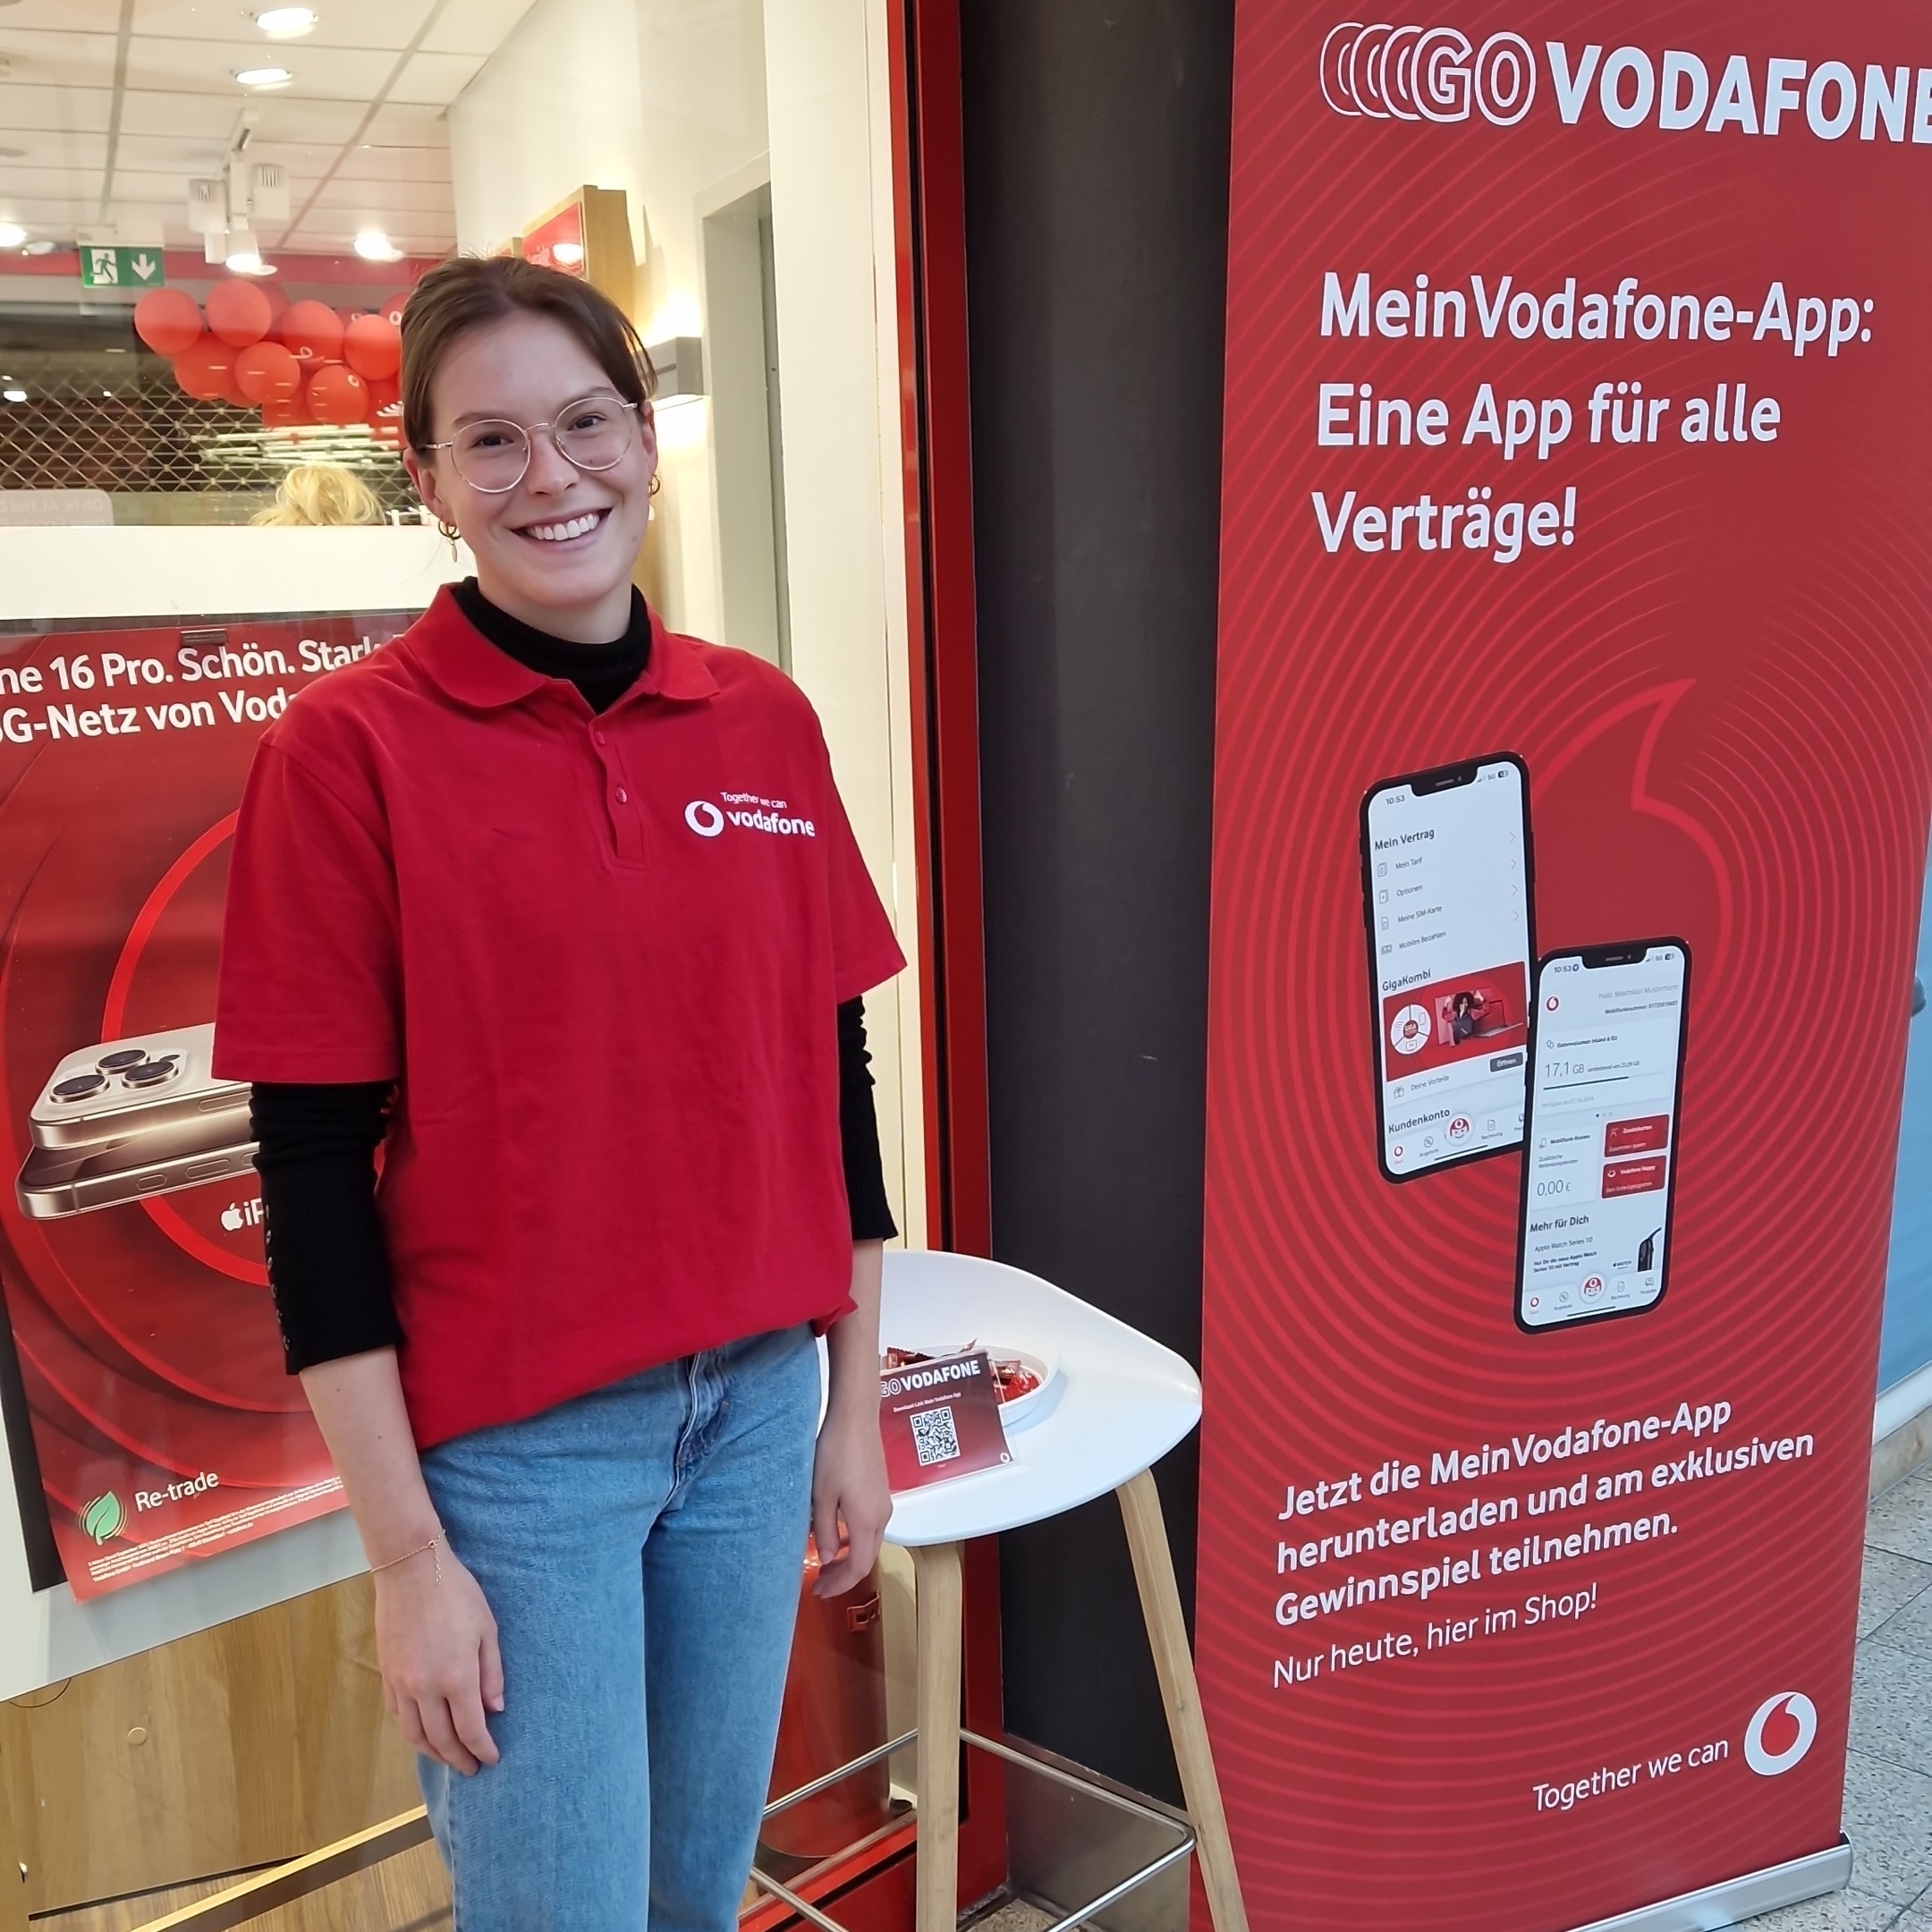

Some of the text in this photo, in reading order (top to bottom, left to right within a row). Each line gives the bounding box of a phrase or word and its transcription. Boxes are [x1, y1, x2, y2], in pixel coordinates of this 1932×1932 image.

[1546, 41, 1932, 143] VODAFONE
[1319, 271, 1875, 357] MeinVodafone-App:
[1317, 382, 1782, 461] Eine App für alle
[1311, 487, 1577, 564] Verträge!
[49, 654, 96, 691] 16
[101, 652, 174, 688] Pro.
[178, 643, 296, 682] Schön.
[0, 687, 297, 743] G-Netz von Vod
[720, 792, 787, 809] Together we can
[1385, 794, 1405, 805] 10:53
[726, 809, 816, 837] vodafone
[1375, 828, 1435, 851] Mein Vertrag
[1395, 857, 1423, 869] Mein Tarif
[1396, 884, 1423, 896] Optionen
[1382, 969, 1431, 991] GigaKombi
[1554, 965, 1572, 973] 10:53
[1411, 1074, 1450, 1091] Deine Vorteile
[1546, 1062, 1570, 1078] 17,1
[1572, 1063, 1584, 1074] GB
[1388, 1109, 1450, 1134] Kundenkonto
[1537, 1179, 1563, 1197] 0,00
[1530, 1215, 1589, 1233] Mehr für Dich
[1535, 1244, 1550, 1252] Apple
[1551, 1241, 1568, 1249] Watch
[1568, 1237, 1585, 1246] Series
[900, 1360, 980, 1391] VODAFONE
[1278, 1399, 1733, 1521] Jetzt die MeinVodafone-App
[134, 1470, 220, 1513] Re-trade
[1276, 1433, 1815, 1574] herunterladen und am exklusiven
[1275, 1512, 1679, 1626] Gewinnspiel teilnehmen.
[1272, 1581, 1598, 1688] Nur heute, hier im Shop!
[1532, 1739, 1729, 1812] Together we can
